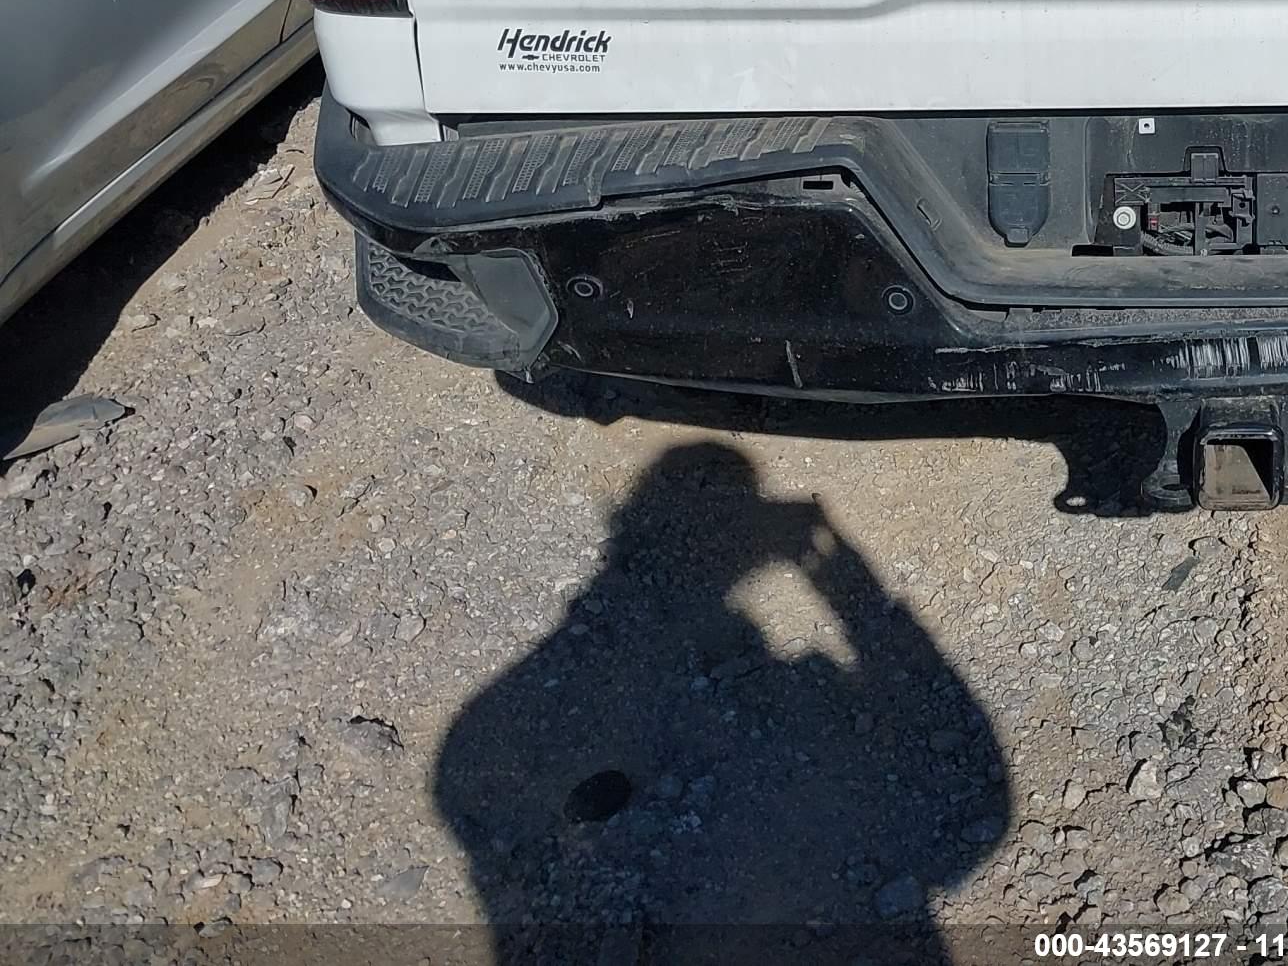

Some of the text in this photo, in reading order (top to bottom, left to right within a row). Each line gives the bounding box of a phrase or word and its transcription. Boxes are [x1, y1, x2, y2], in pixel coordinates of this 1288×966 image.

[497, 28, 612, 59] Hendrick
[542, 54, 605, 62] CHEVROLET
[499, 63, 601, 74] www.chevyusa.com
